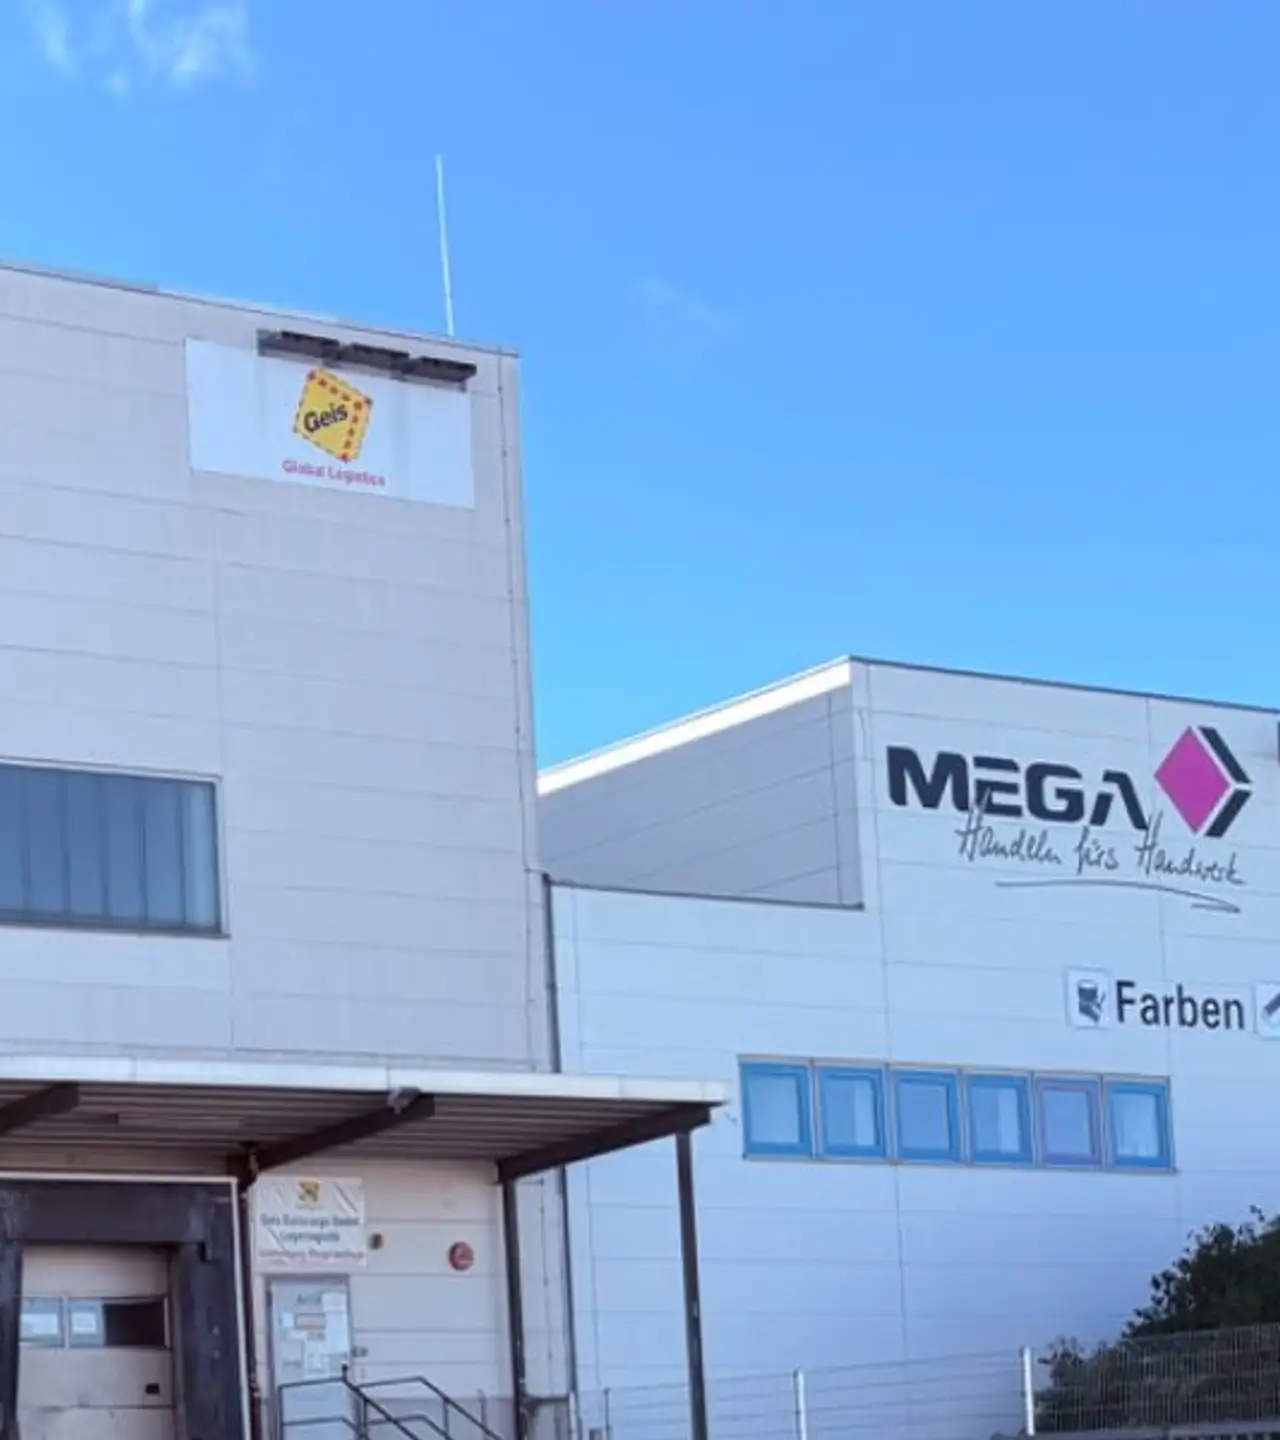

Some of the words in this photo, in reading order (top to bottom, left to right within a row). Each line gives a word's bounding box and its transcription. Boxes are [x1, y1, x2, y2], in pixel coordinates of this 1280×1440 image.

[303, 402, 348, 434] Geis
[282, 458, 325, 478] Global
[328, 465, 385, 487] Logistics
[886, 745, 1147, 831] MEGA
[954, 788, 1061, 864] Handeln
[1074, 825, 1120, 876] fürs
[1134, 810, 1246, 886] Handwerk
[1116, 980, 1244, 1030] Farben
